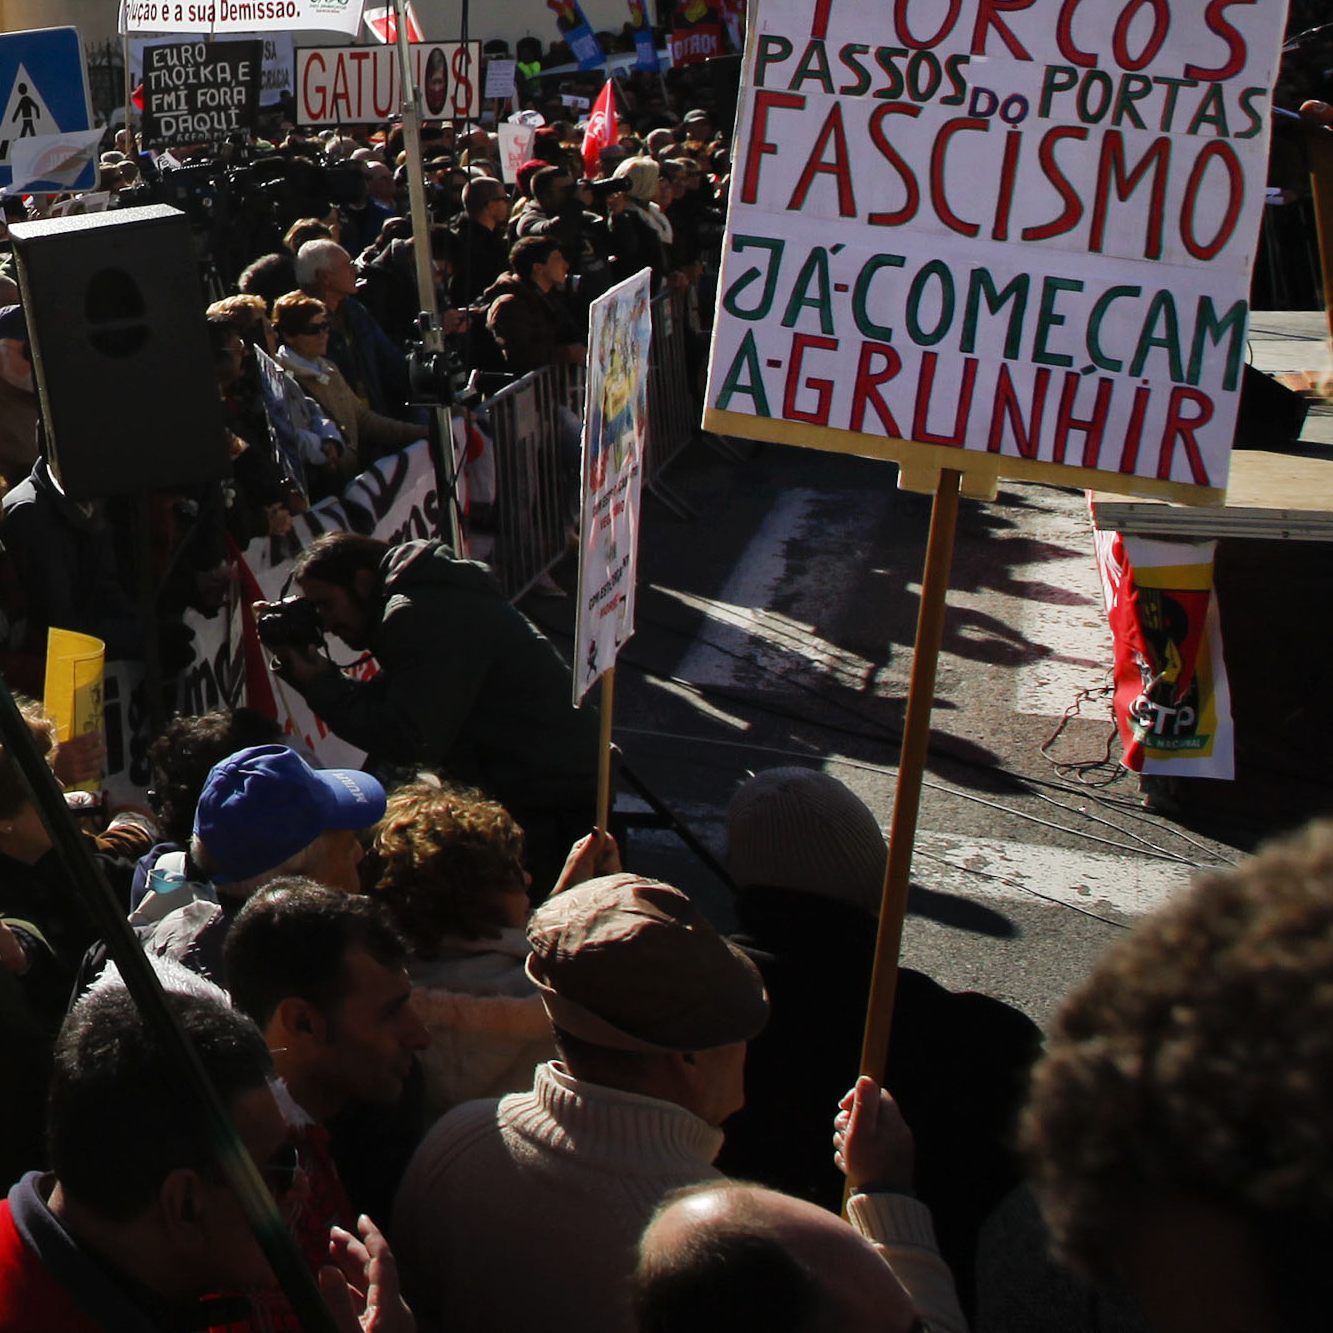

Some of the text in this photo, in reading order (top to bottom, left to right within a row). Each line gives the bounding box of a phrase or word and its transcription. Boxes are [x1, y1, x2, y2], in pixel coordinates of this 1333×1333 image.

[174, 5, 183, 22] a
[188, 3, 216, 23] sua
[152, 43, 207, 68] EURO
[238, 62, 251, 81] E
[151, 86, 246, 112] FMI FORA
[753, 34, 1269, 139] PASSOS DO PORTAS
[160, 107, 240, 137] DAQUI
